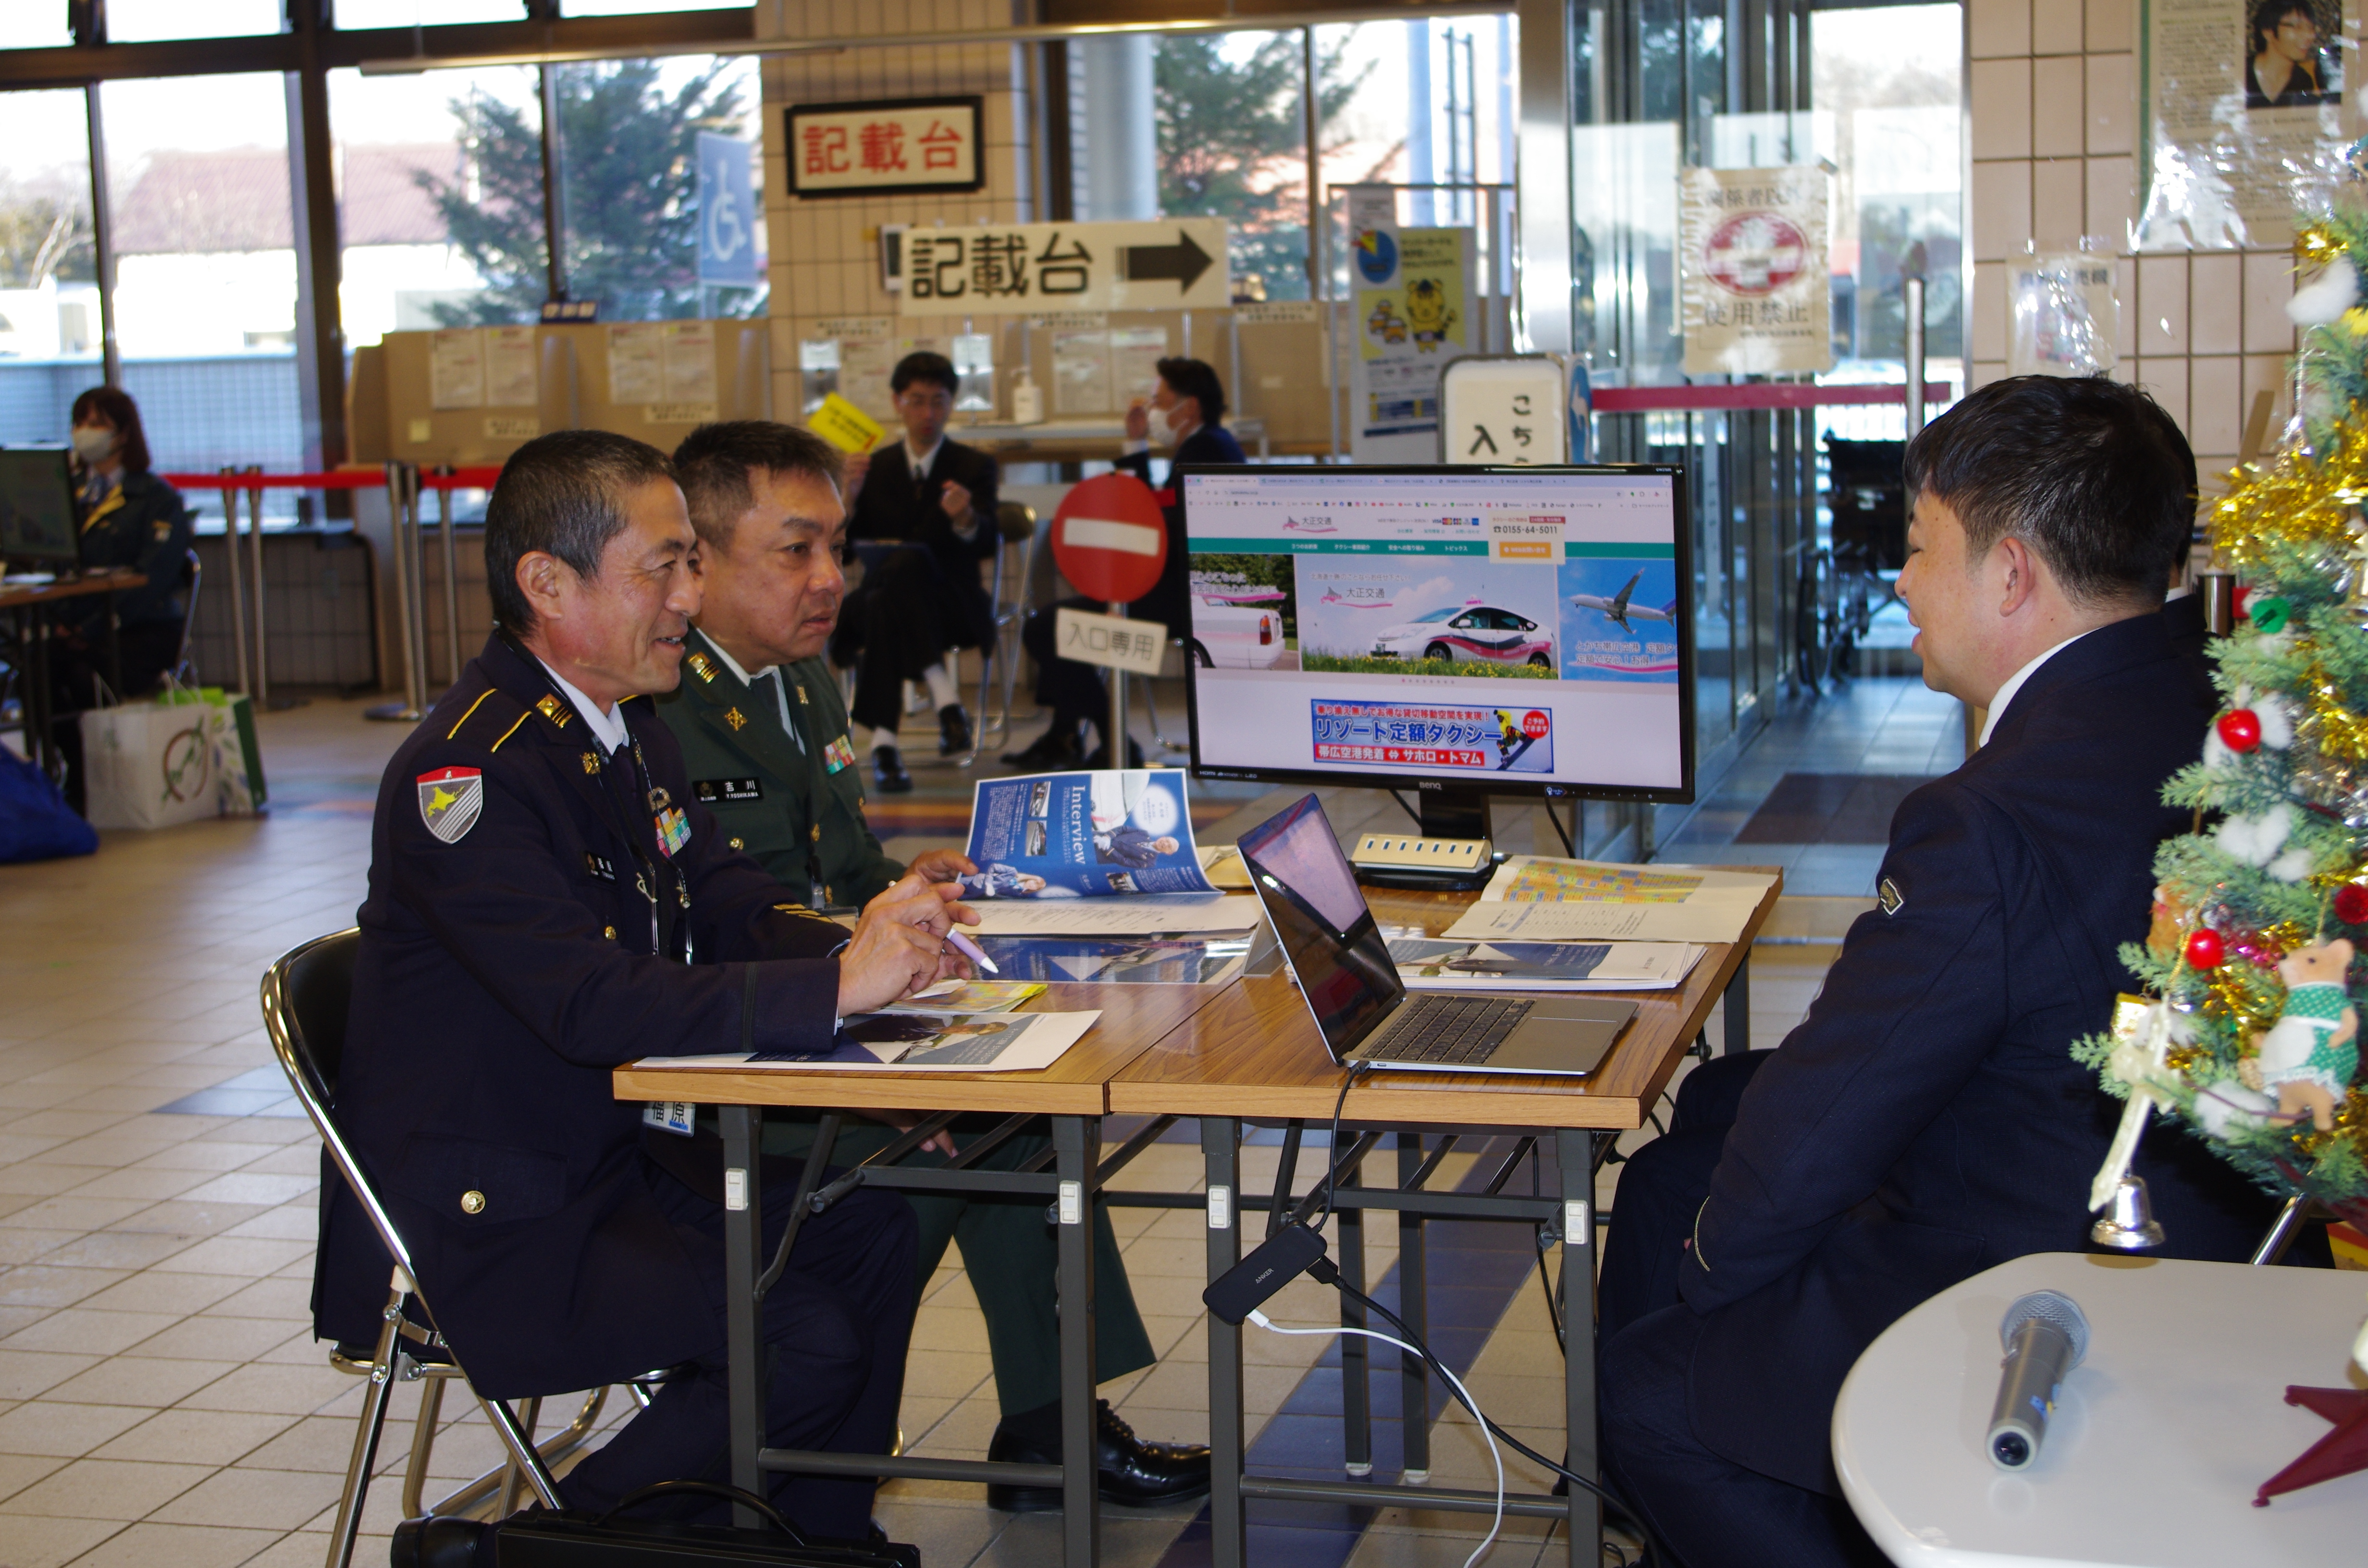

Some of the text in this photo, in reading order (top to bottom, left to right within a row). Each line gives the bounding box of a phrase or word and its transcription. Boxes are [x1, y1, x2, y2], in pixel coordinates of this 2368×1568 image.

[802, 120, 963, 176] 記載台
[911, 232, 1092, 299] 記載台
[1703, 301, 1809, 327] 使用禁止
[1302, 516, 1332, 525] 大正交通
[1503, 526, 1557, 534] 0155-64-5011
[1346, 588, 1385, 599] 大正交通
[1067, 623, 1155, 661] 入口専用
[1576, 641, 1640, 652] とかち帯広空港
[1316, 704, 1490, 722] 乗り換え無しでお得な貸切移動空間を実現！
[1316, 718, 1504, 746] リゾート定額タクシー
[1319, 744, 1482, 765] 帯広空港発着 サホロ・トマム
[445, 770, 453, 779] 4
[1072, 785, 1087, 865] Interview
[1255, 1268, 1274, 1284] ANKER
